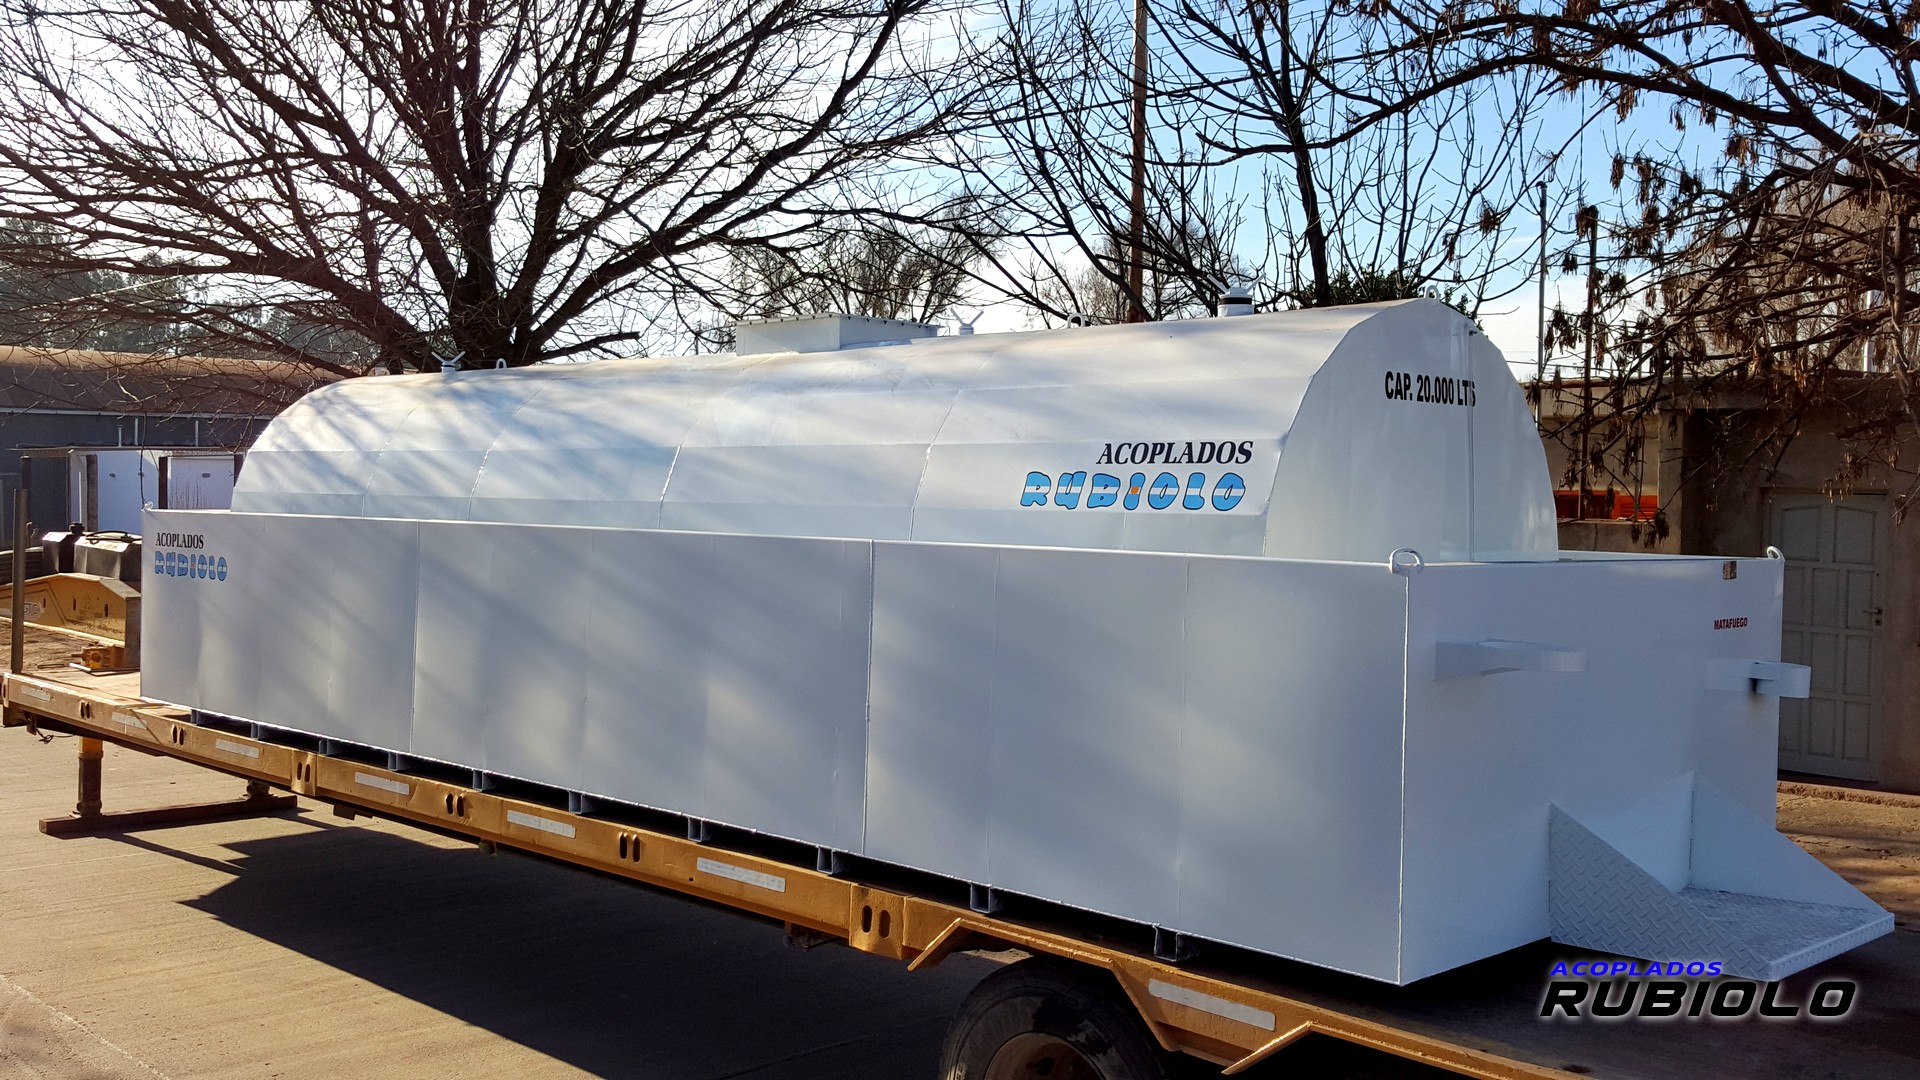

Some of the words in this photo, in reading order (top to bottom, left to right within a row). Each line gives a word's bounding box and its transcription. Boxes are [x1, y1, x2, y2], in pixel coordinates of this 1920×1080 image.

[1385, 371, 1412, 401] CAP.
[1417, 374, 1454, 405] 20.000
[1096, 441, 1253, 464] ACOPLADOS
[1020, 471, 1246, 511] RUBIOLO
[156, 532, 204, 549] ACOPLADOS
[155, 551, 228, 581] RUBIOLO
[1714, 617, 1748, 630] MATAFUEGO
